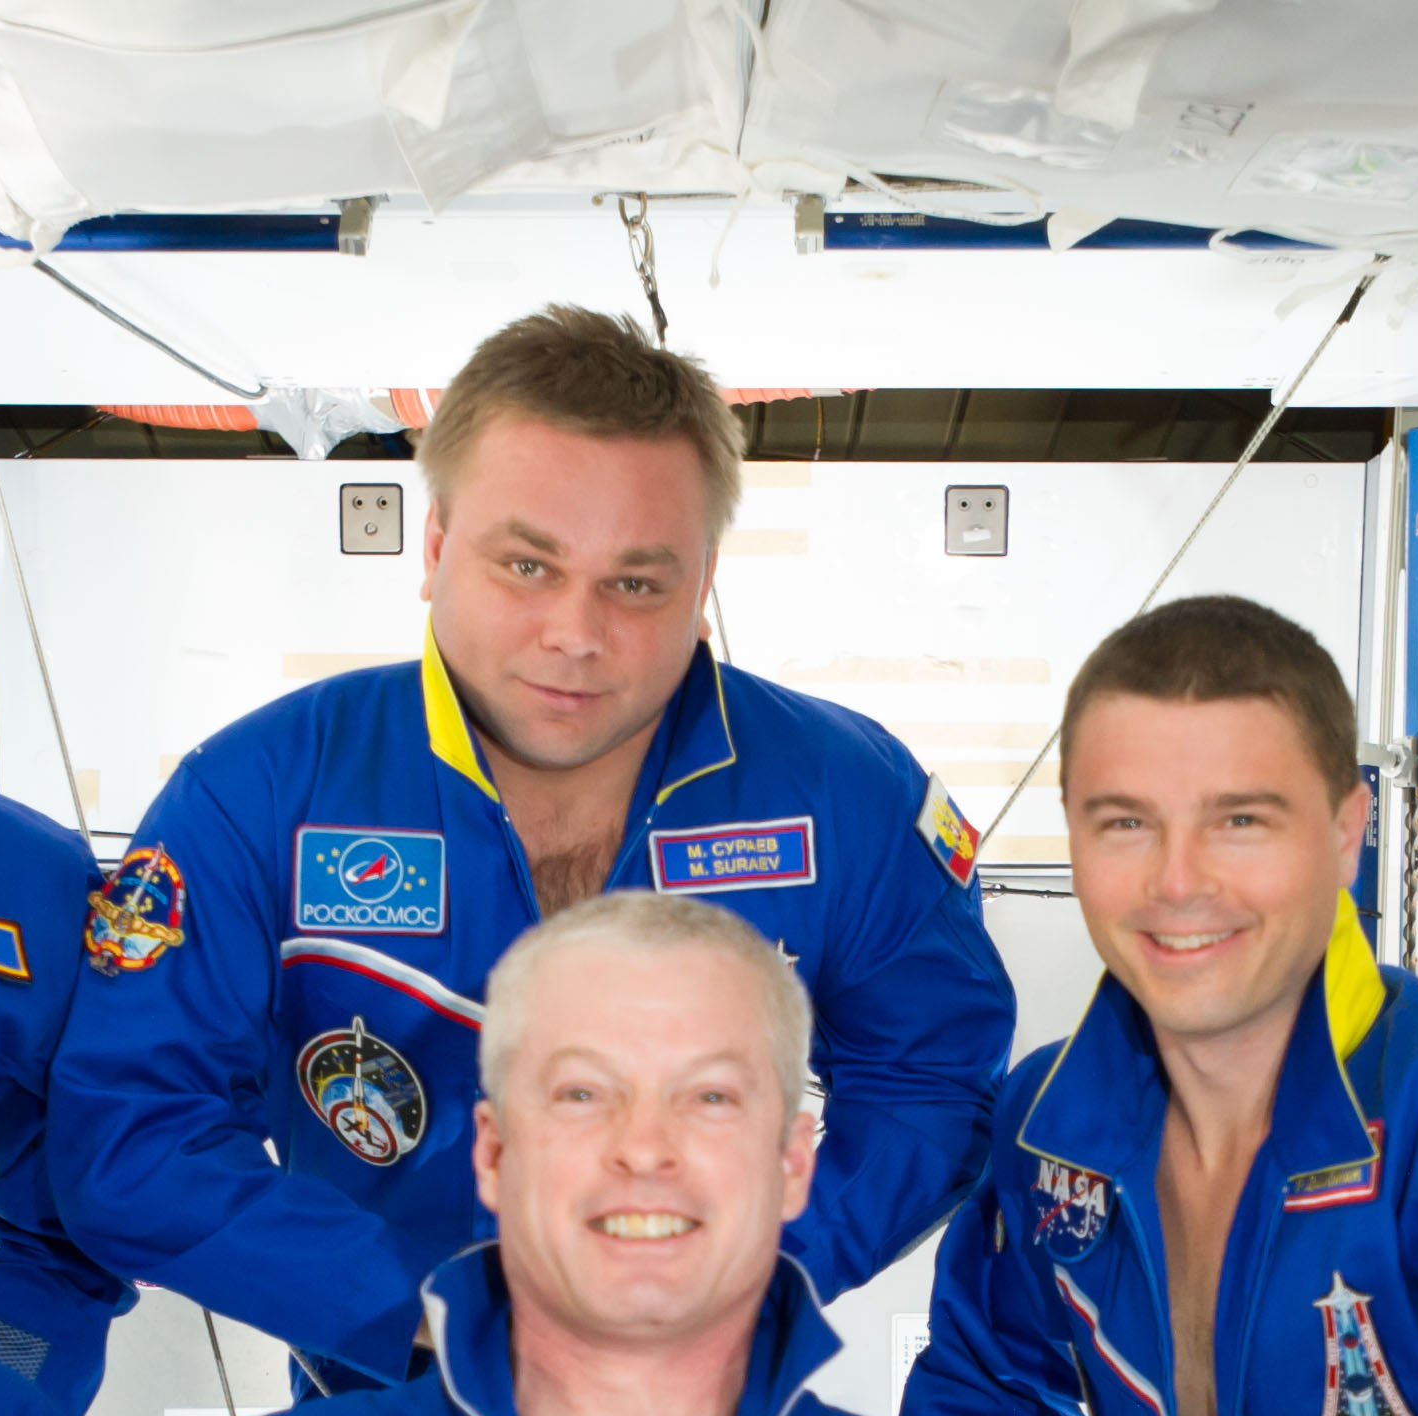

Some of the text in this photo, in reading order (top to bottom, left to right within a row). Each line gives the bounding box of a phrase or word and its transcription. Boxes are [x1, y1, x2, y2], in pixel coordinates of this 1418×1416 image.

[712, 837, 778, 857] СУРАЕВ
[713, 856, 781, 875] SURAEV
[302, 904, 437, 926] РОСКОСМОС
